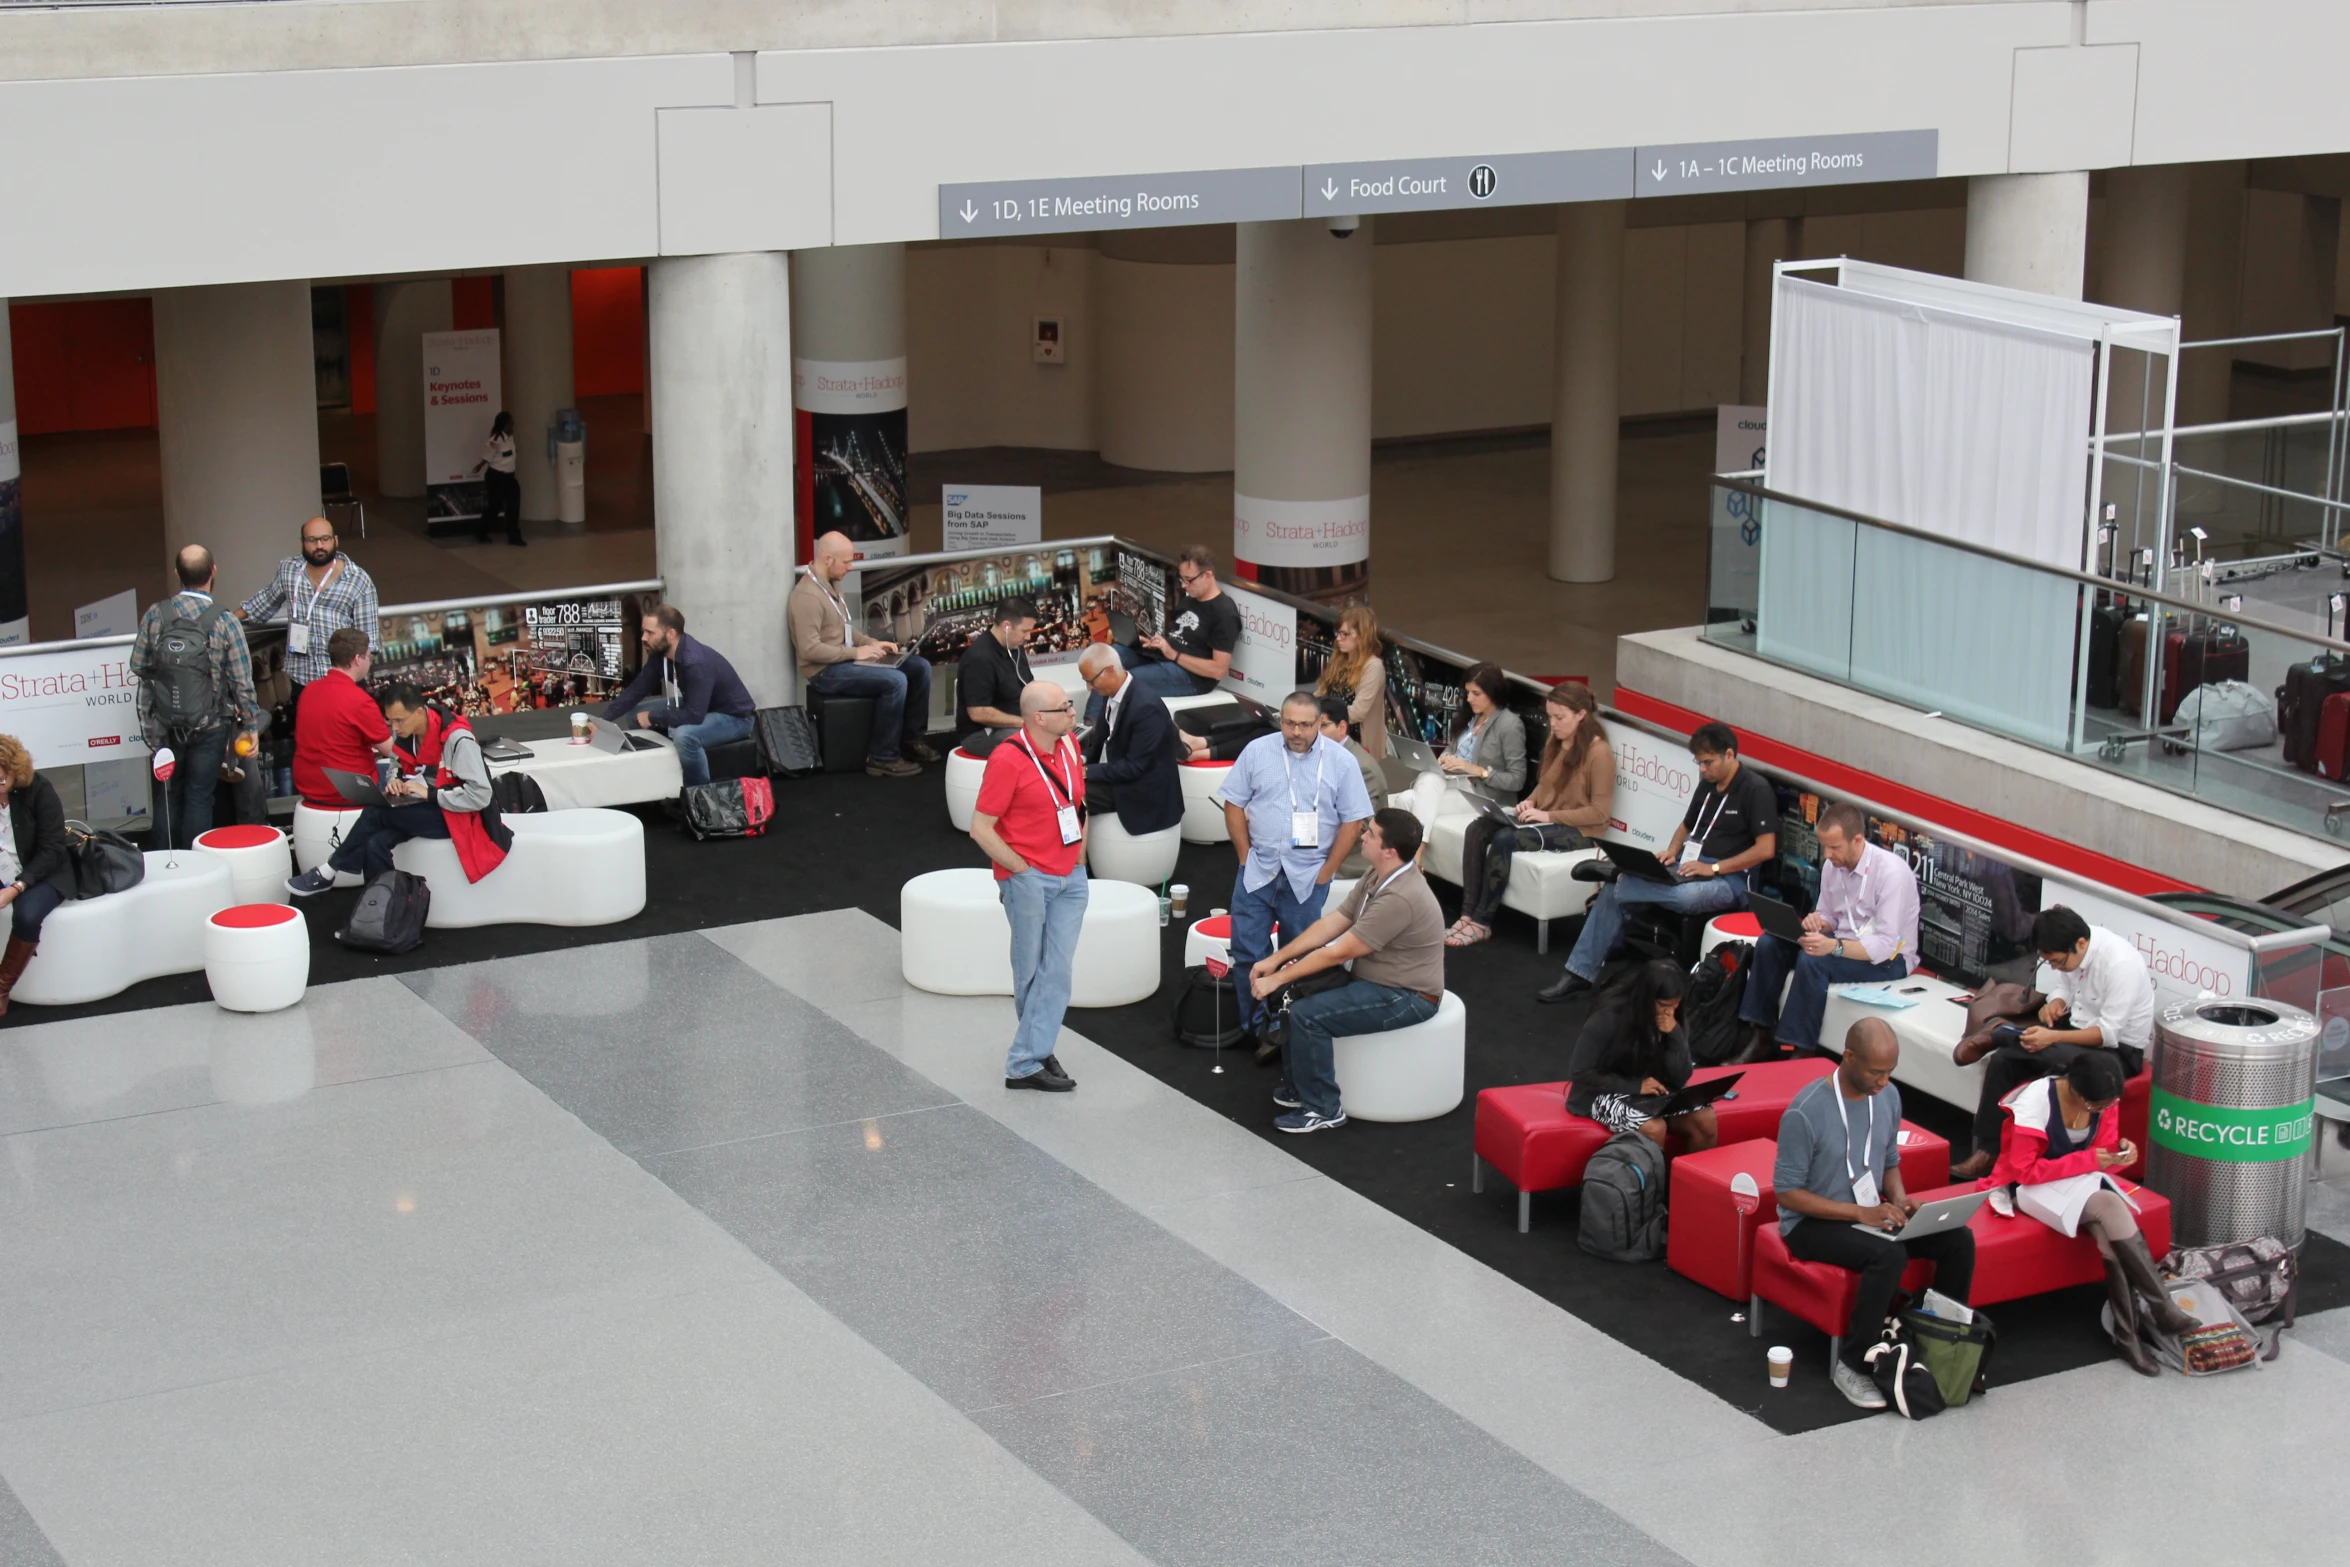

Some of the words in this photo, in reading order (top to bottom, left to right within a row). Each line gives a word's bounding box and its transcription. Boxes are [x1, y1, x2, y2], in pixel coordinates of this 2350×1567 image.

[1679, 159, 1699, 178] 1A
[1718, 157, 1738, 175] 1C
[1741, 154, 1806, 175] Meeting
[1811, 151, 1863, 169] Rooms
[1350, 177, 1393, 197] Food
[1398, 175, 1447, 195] Court
[992, 200, 1022, 221] 1D,
[1028, 198, 1049, 217] 1E
[1054, 195, 1131, 218] Meeting
[1137, 192, 1199, 212] Rooms
[430, 380, 481, 393] Keynotes
[430, 396, 439, 406] &
[441, 393, 488, 405] Sessions
[947, 510, 962, 520] Big
[964, 511, 984, 519] Data
[987, 511, 1026, 520] Sessions
[970, 521, 989, 529] SAP
[1266, 520, 1368, 540] Strata+Hadoop
[556, 603, 580, 624] 788
[86, 692, 132, 707] WORLD
[89, 737, 118, 747] O'REILLY
[1632, 827, 1655, 842] cloudera
[1912, 851, 1934, 884] 211
[1934, 867, 1954, 883] Central
[1955, 875, 1968, 888] Park
[1969, 879, 1984, 895] West
[1934, 878, 1947, 889] New
[1962, 889, 1972, 900] NY
[1972, 893, 1992, 908] 10024
[1965, 905, 1977, 916] 2014
[1978, 911, 1991, 923] Sales
[2175, 1116, 2269, 1145] RECYCLE
